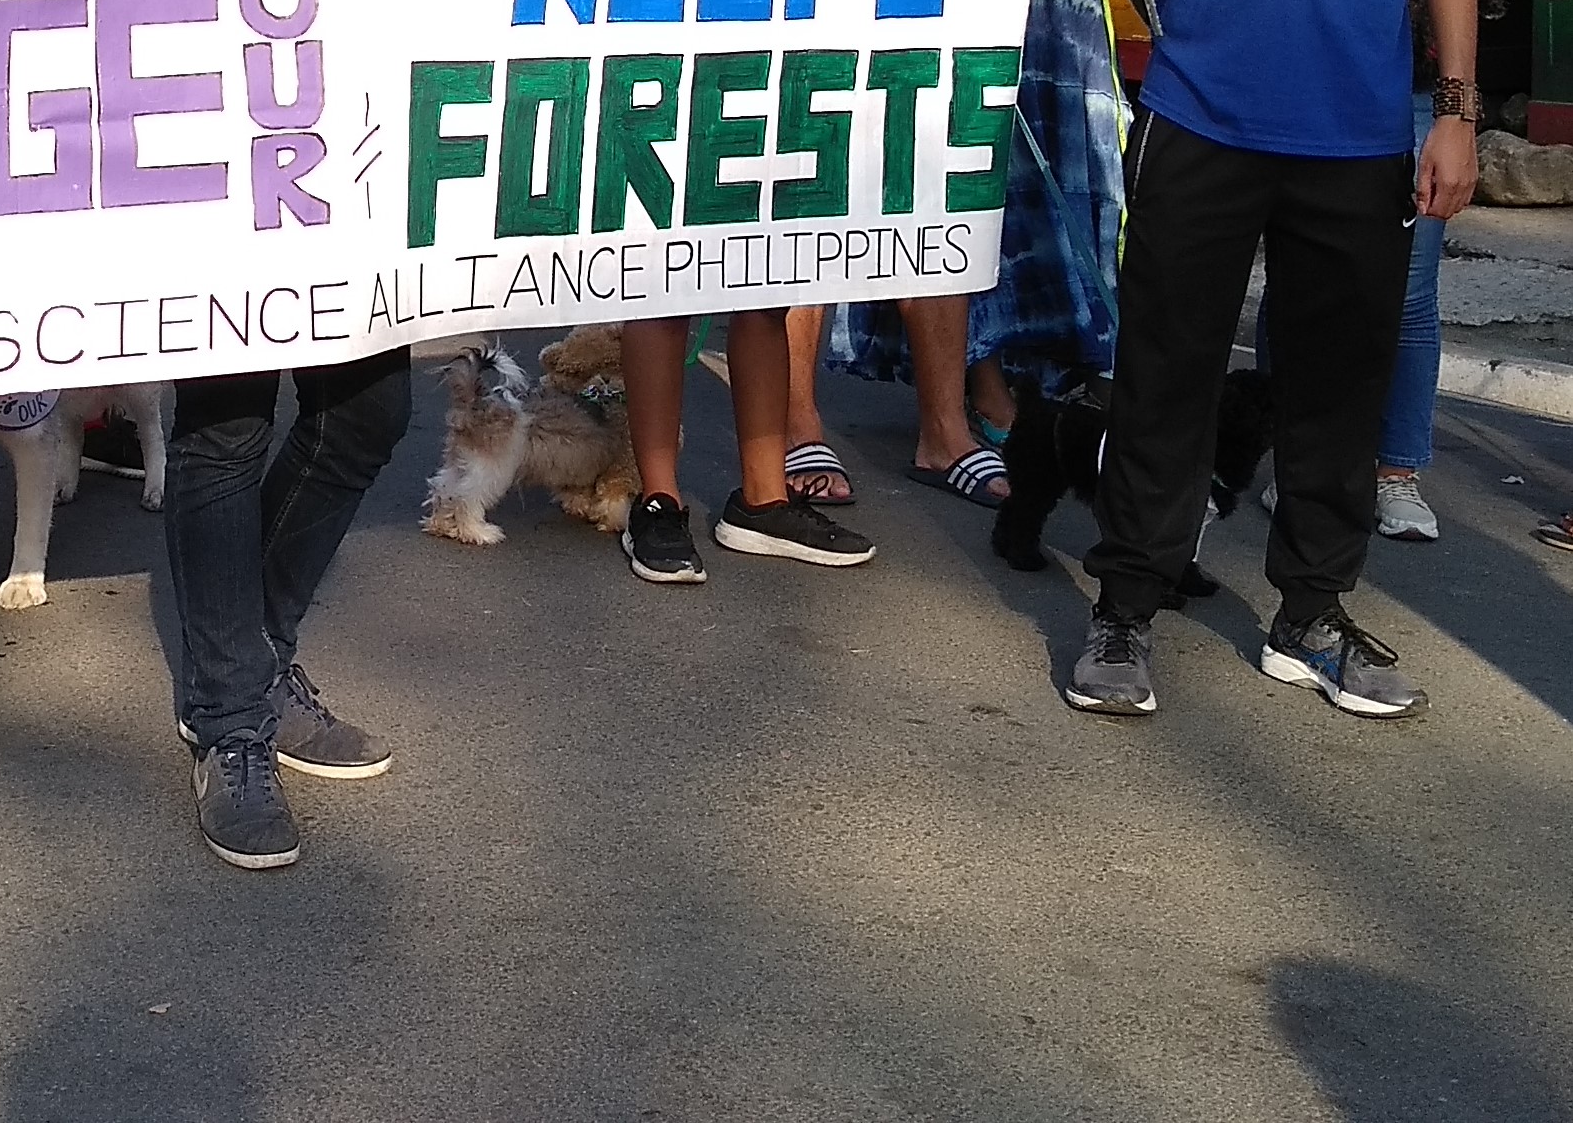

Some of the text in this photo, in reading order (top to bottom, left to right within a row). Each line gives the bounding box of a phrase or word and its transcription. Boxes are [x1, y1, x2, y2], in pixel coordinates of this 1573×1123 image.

[406, 46, 1022, 249] FORESTS
[367, 243, 647, 334] ALLIANCE
[664, 223, 973, 294] PHILIPPINES
[18, 393, 48, 423] OUR
